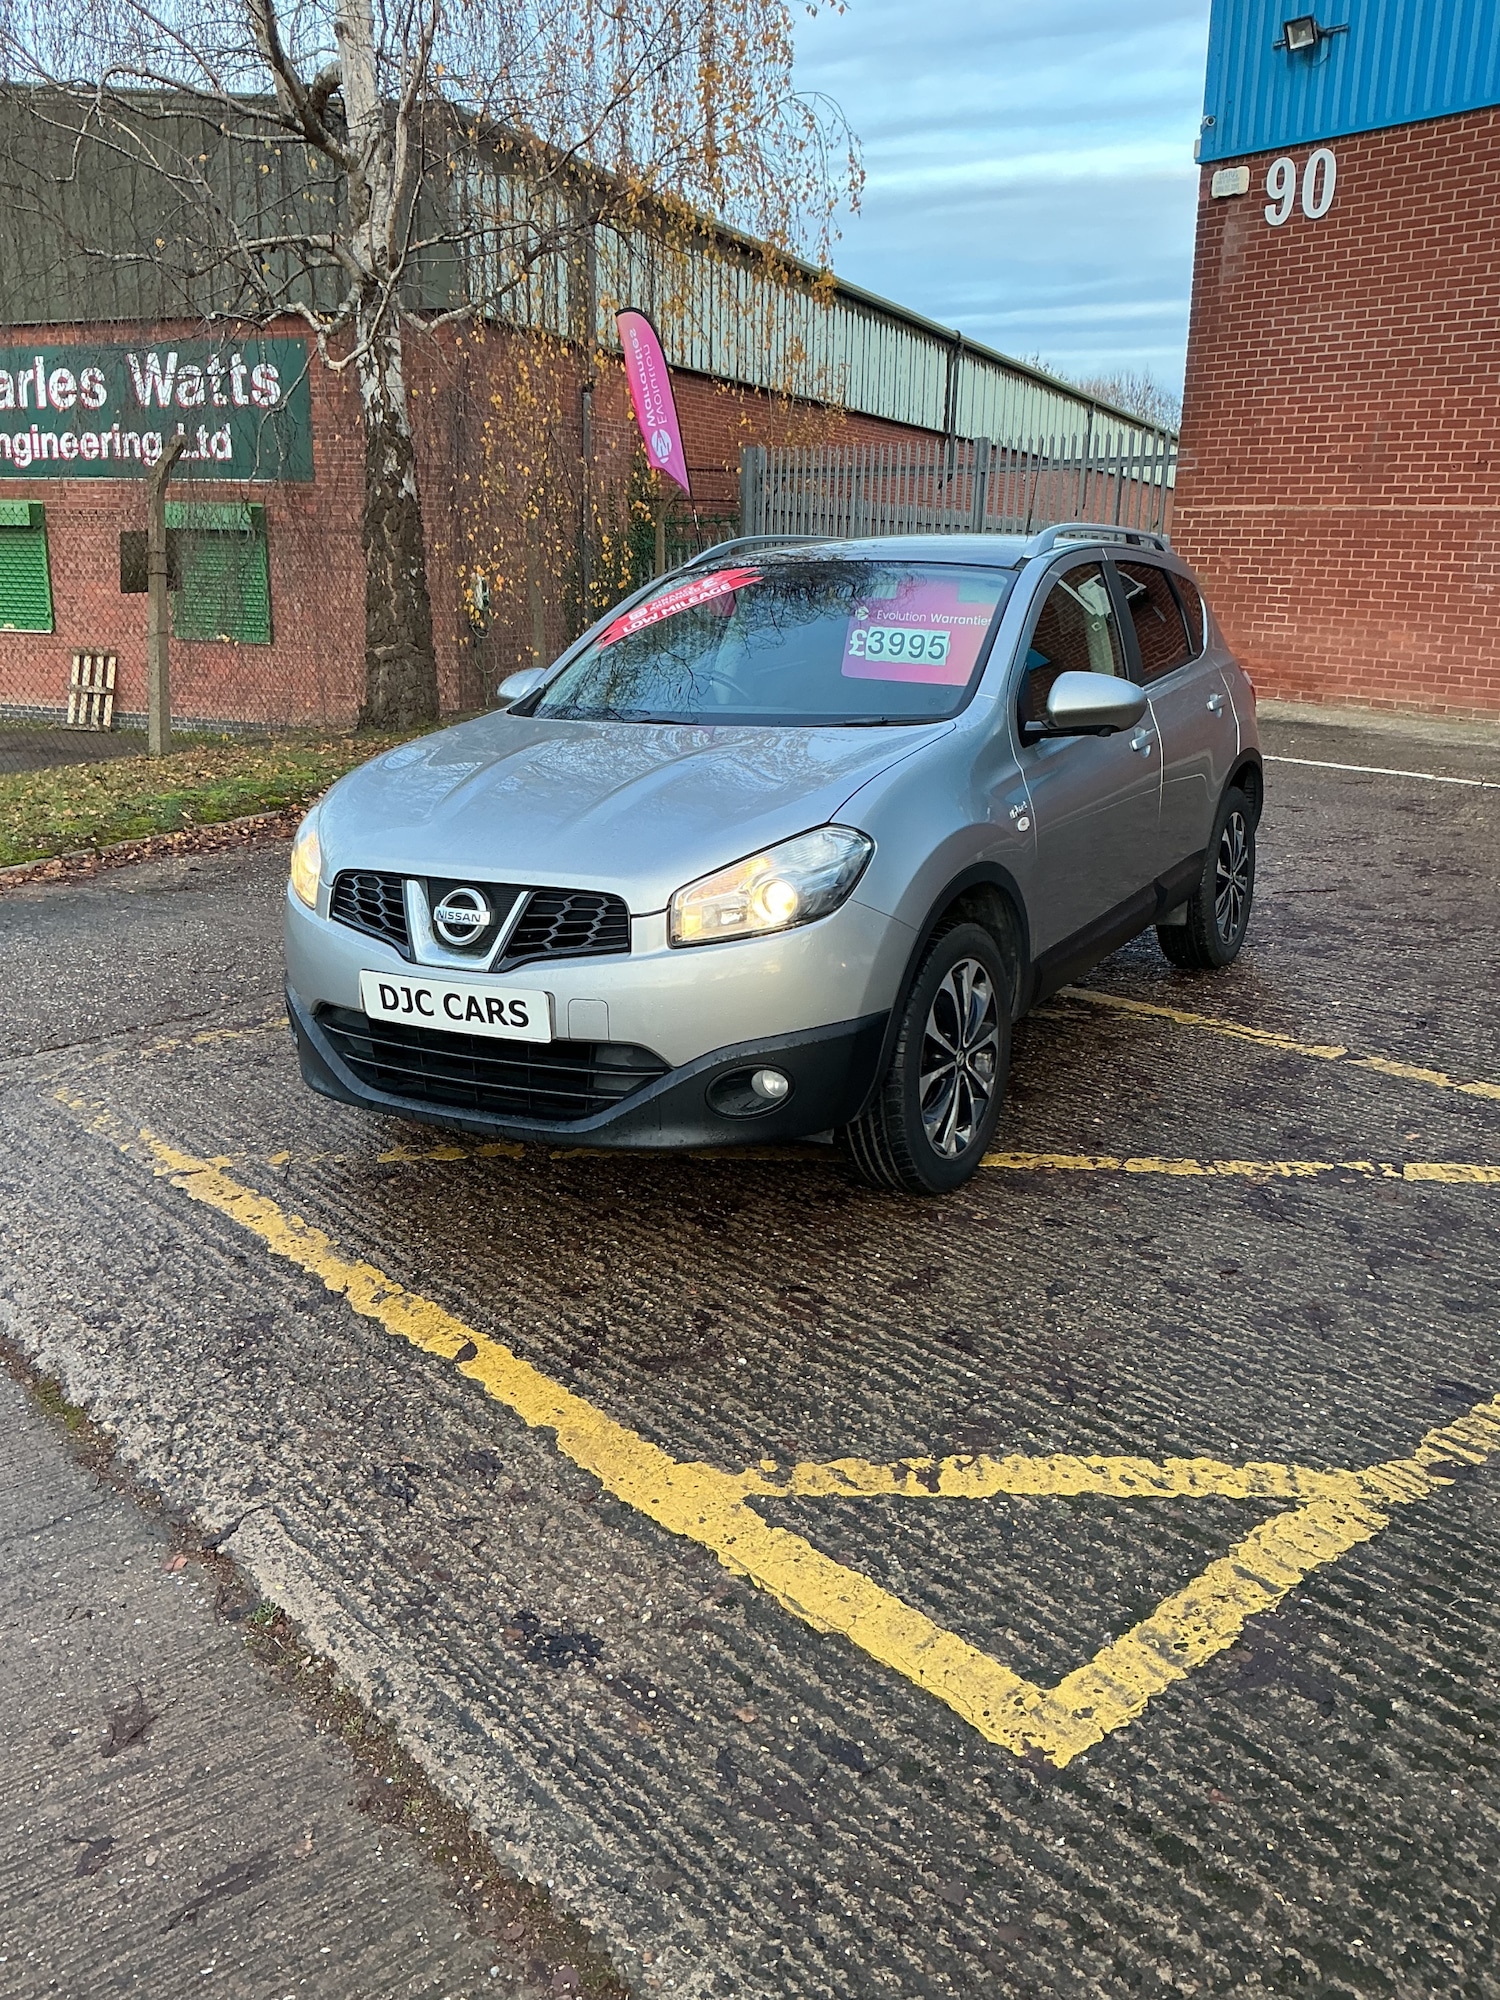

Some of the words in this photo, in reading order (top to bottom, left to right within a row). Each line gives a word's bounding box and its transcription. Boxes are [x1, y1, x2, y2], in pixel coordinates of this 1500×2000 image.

[1264, 148, 1338, 226] 90
[125, 352, 282, 408] Watts
[622, 613, 659, 634] LOW
[660, 582, 732, 616] MILEAGE
[876, 610, 927, 622] Evolution
[438, 910, 482, 923] NISSAN
[378, 983, 435, 1017] DJC
[442, 992, 530, 1028] CARS
